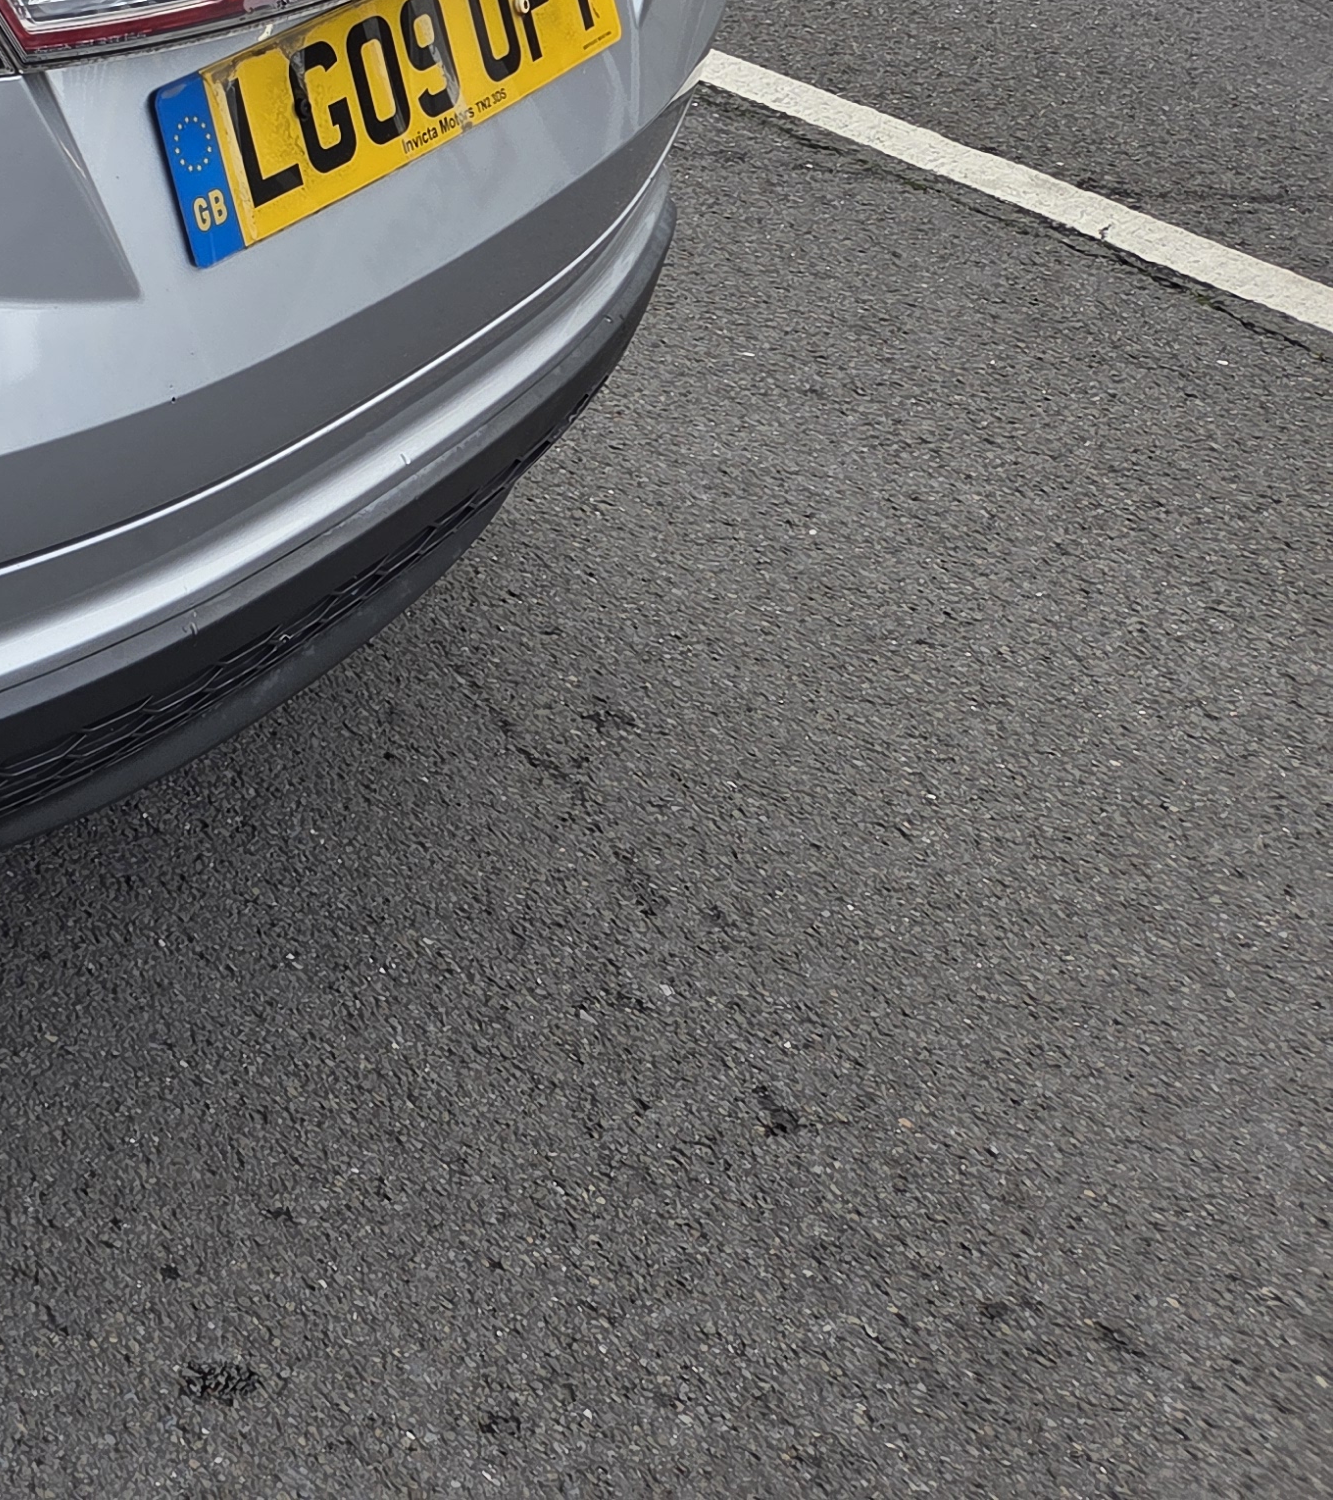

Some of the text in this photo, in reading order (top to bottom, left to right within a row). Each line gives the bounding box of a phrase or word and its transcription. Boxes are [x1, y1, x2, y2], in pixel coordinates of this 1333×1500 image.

[401, 127, 438, 154] Invicta
[475, 97, 492, 113] TN2
[193, 188, 229, 232] GB
